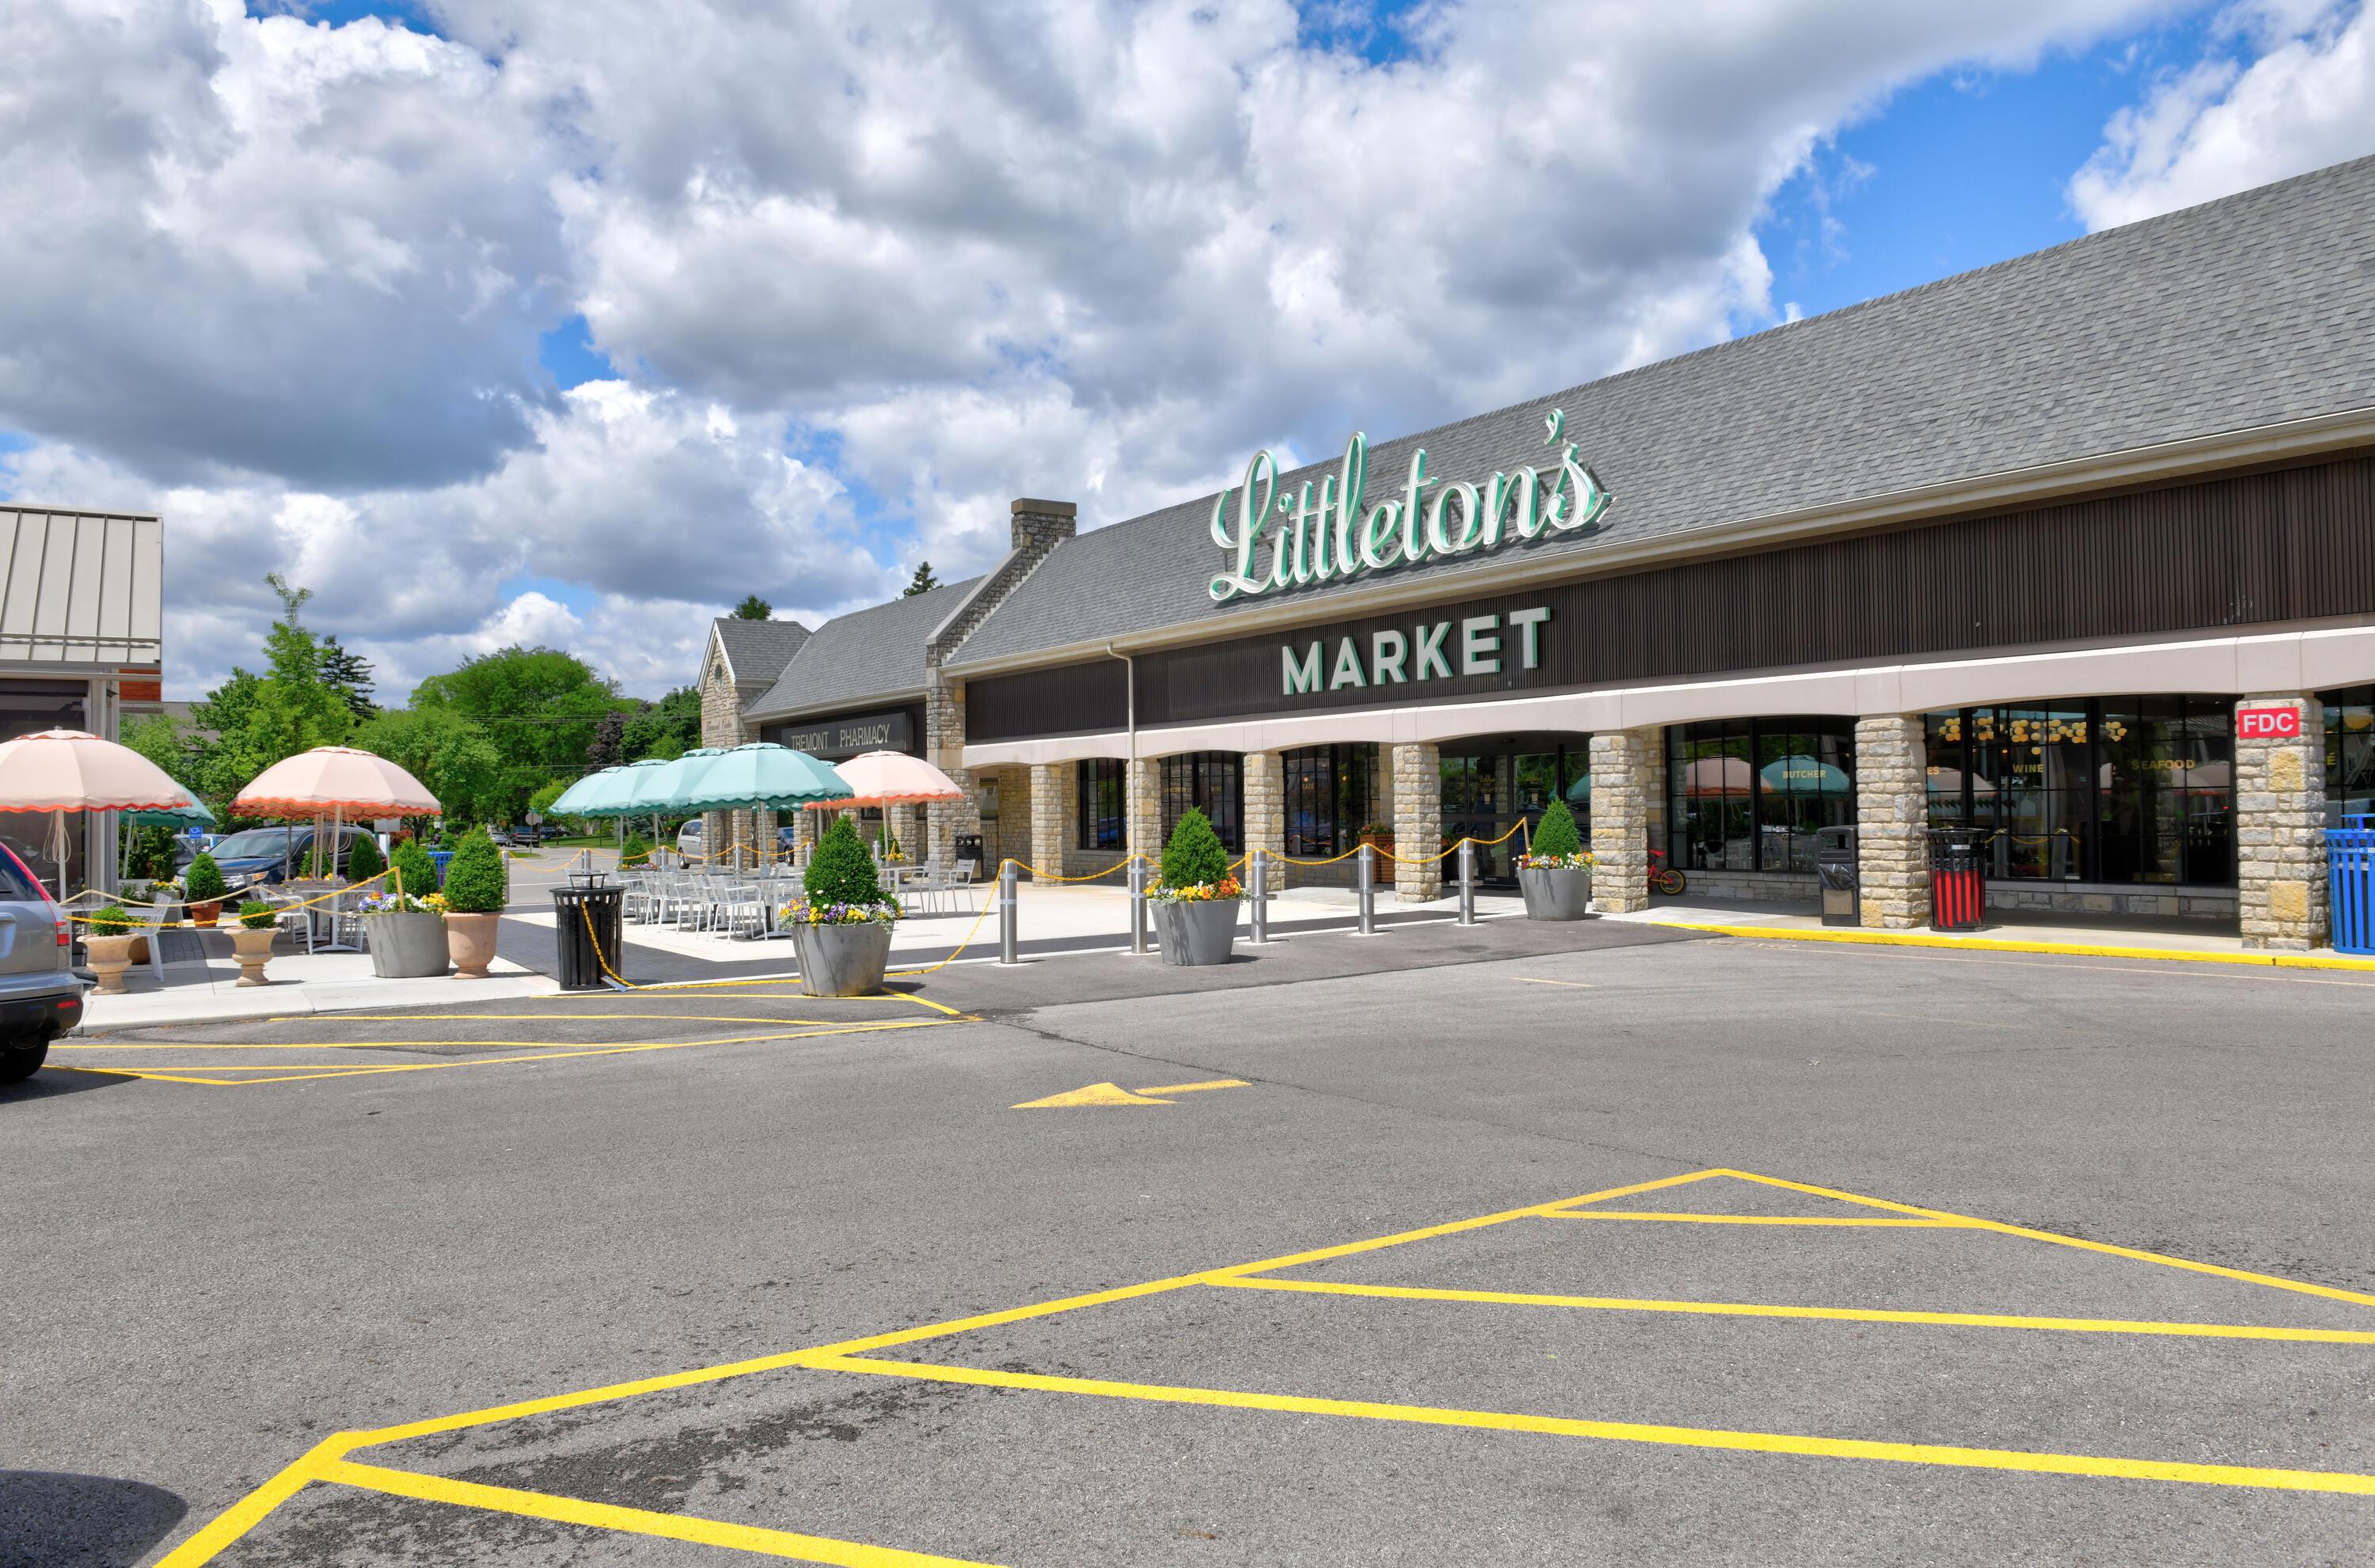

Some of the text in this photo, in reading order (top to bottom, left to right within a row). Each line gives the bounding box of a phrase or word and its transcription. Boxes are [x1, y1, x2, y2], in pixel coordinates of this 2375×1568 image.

[1209, 408, 1610, 601] Littleton's
[1282, 606, 1551, 694] MARKET
[2244, 713, 2293, 733] FDC
[791, 723, 890, 751] TREMONT PHARMACY
[1782, 770, 1826, 779] BUTCHER
[2012, 764, 2044, 773] WINE
[2131, 760, 2196, 770] SEAFOOD
